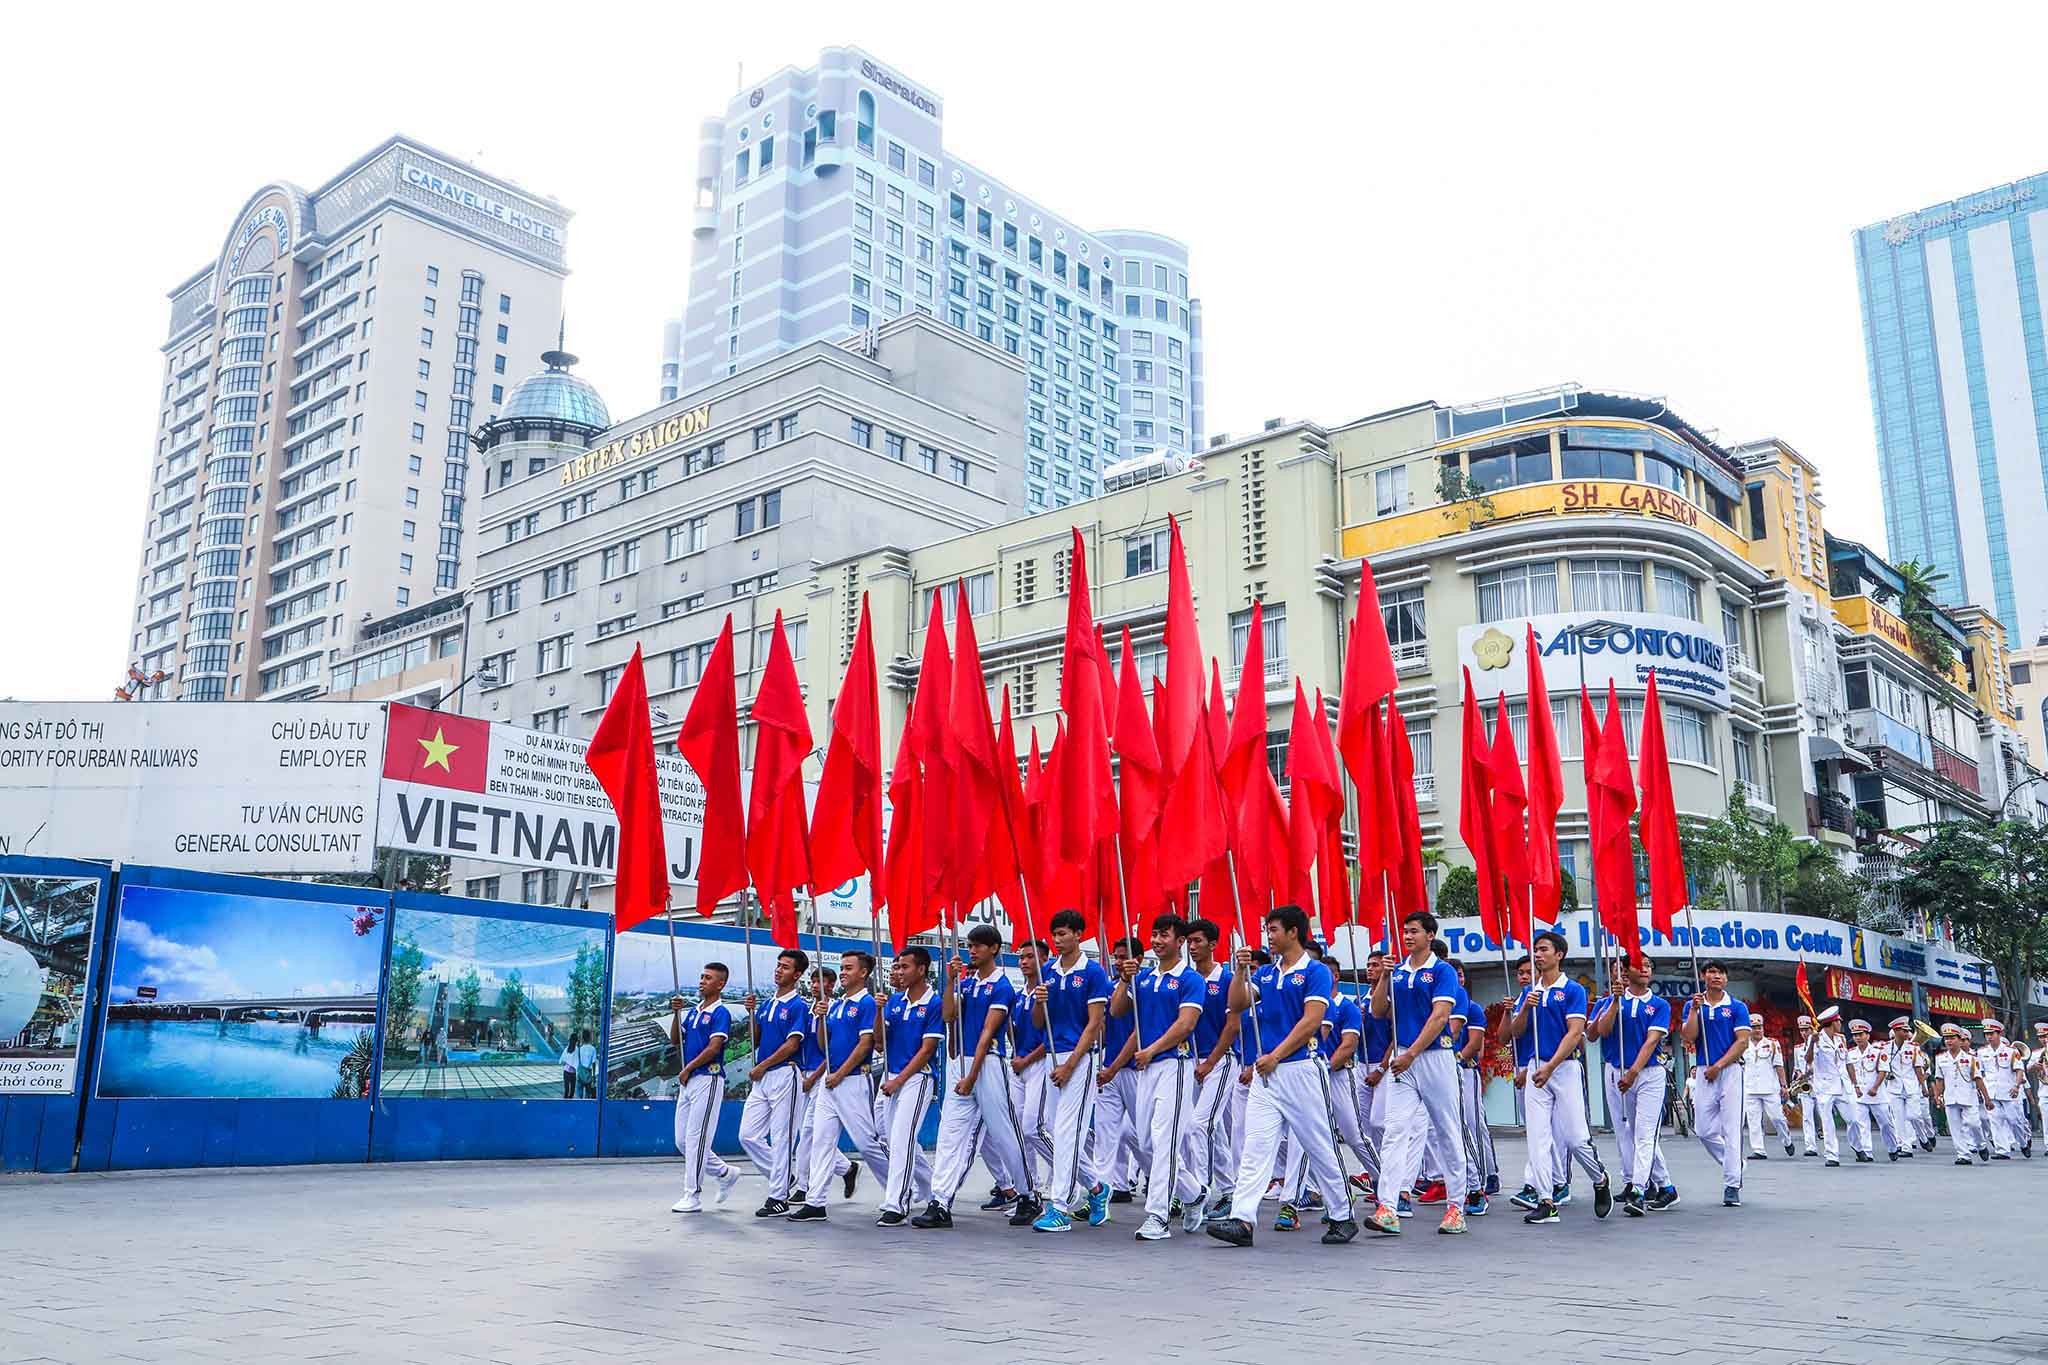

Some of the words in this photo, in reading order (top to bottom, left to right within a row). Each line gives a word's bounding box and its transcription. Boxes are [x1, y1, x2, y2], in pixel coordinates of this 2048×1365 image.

[860, 59, 937, 117] Sheraton
[407, 168, 505, 219] CARAVELLE
[510, 211, 560, 242] HOTEL
[560, 439, 626, 485] ARTEX
[1620, 485, 1698, 527] GARDEN
[24, 718, 53, 739] SÁT
[56, 718, 77, 739] ĐÔ
[81, 721, 104, 743] THỊ
[272, 718, 305, 740] CHỦ
[347, 722, 370, 740] TƯ
[0, 749, 44, 767] ORITY
[46, 750, 76, 767] FOR
[79, 749, 127, 767] URBAN
[130, 749, 199, 767] RAILWAYS
[279, 749, 367, 767] EMPLOYER
[504, 749, 515, 761] TP
[547, 757, 567, 770] MINH
[515, 767, 529, 780] CHI
[531, 771, 552, 784] MINH
[554, 774, 573, 787] CITY
[574, 779, 602, 792] URBAN
[660, 792, 696, 808] TRUCTION
[489, 780, 507, 792] BEN
[510, 783, 538, 798] THANH
[545, 789, 565, 802] SUOI
[567, 792, 584, 805] TIEN
[586, 795, 614, 810] SECTIO
[662, 808, 692, 822] NTRACT
[241, 805, 264, 823] TƯ
[305, 805, 364, 824] CHUNG
[175, 834, 250, 852] GENERAL
[255, 833, 361, 852] CONSULTANT
[397, 793, 616, 870] VIETNAM
[1578, 920, 1779, 950] Iormation
[0, 1061, 22, 1073] ing
[25, 1061, 65, 1073] Soon;
[30, 1076, 63, 1089] công
